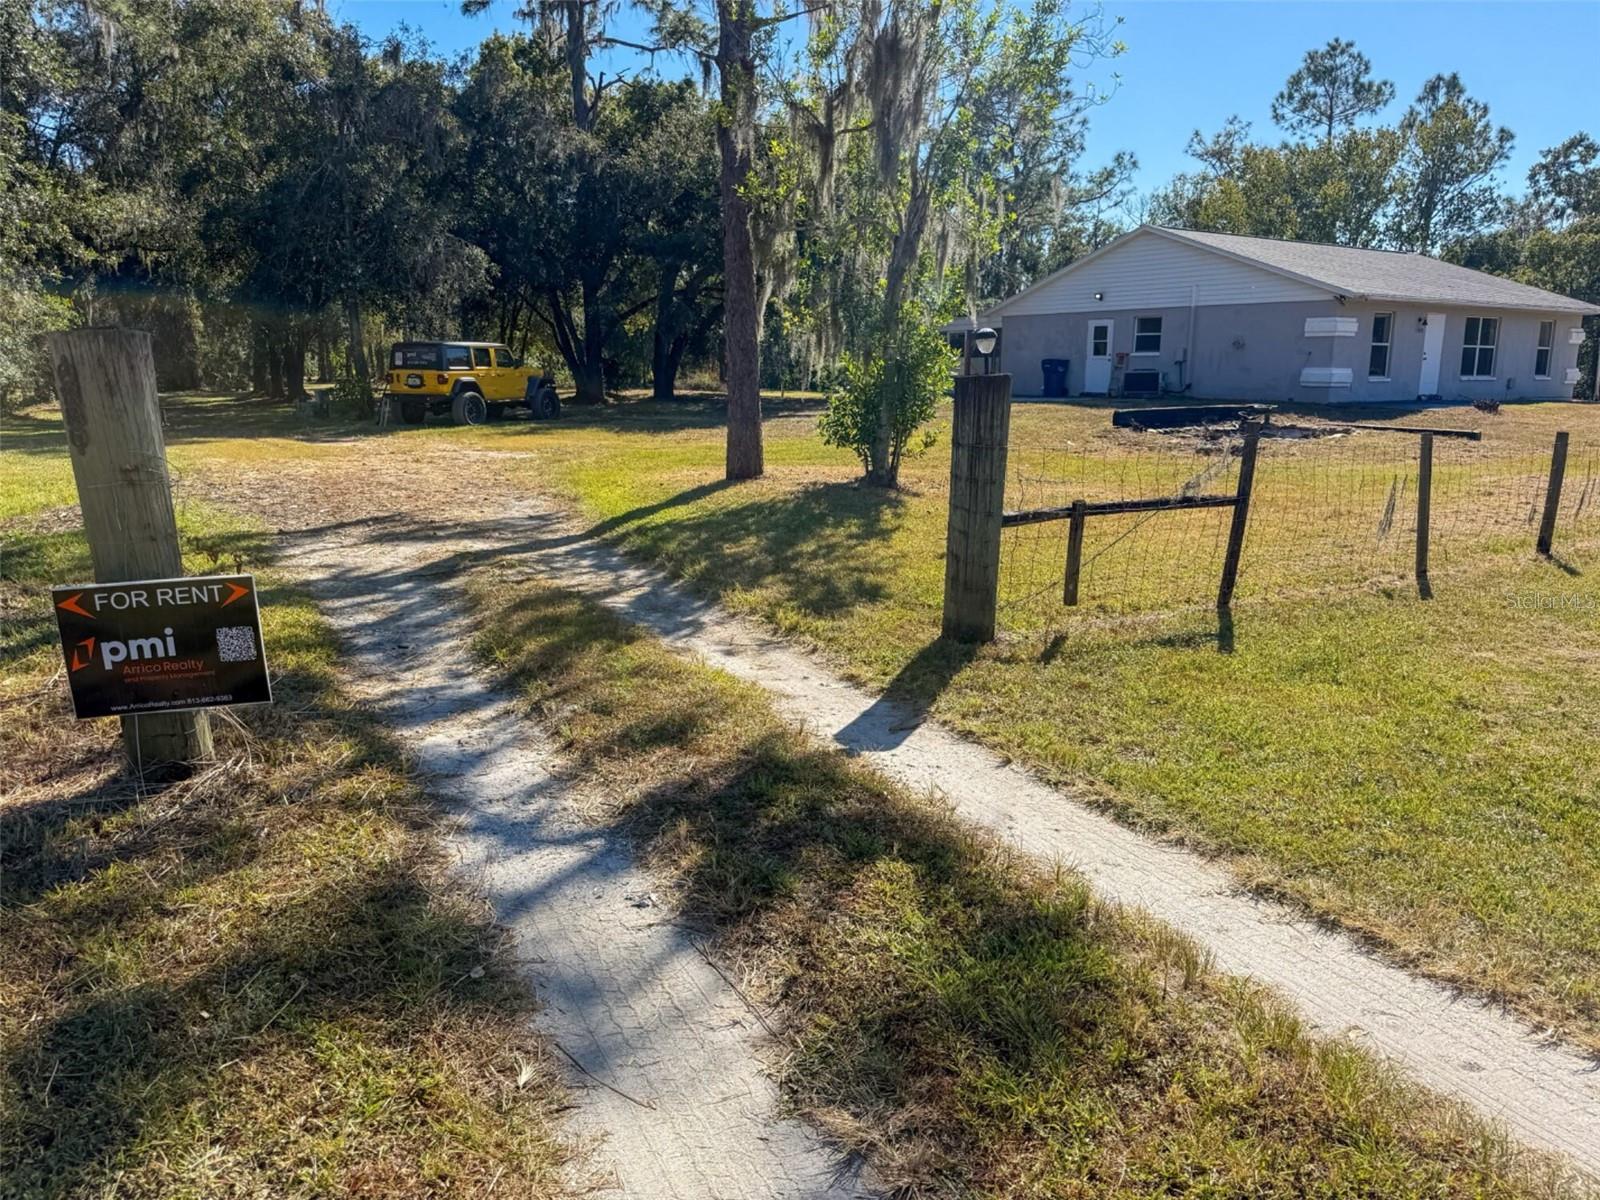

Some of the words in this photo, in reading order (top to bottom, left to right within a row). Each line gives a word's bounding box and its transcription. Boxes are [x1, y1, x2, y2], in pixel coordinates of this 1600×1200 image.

[94, 590, 149, 611] FOR
[156, 585, 223, 606] RENT
[100, 627, 176, 670] pmi
[123, 661, 161, 674] Arrico
[164, 659, 204, 672] Realty
